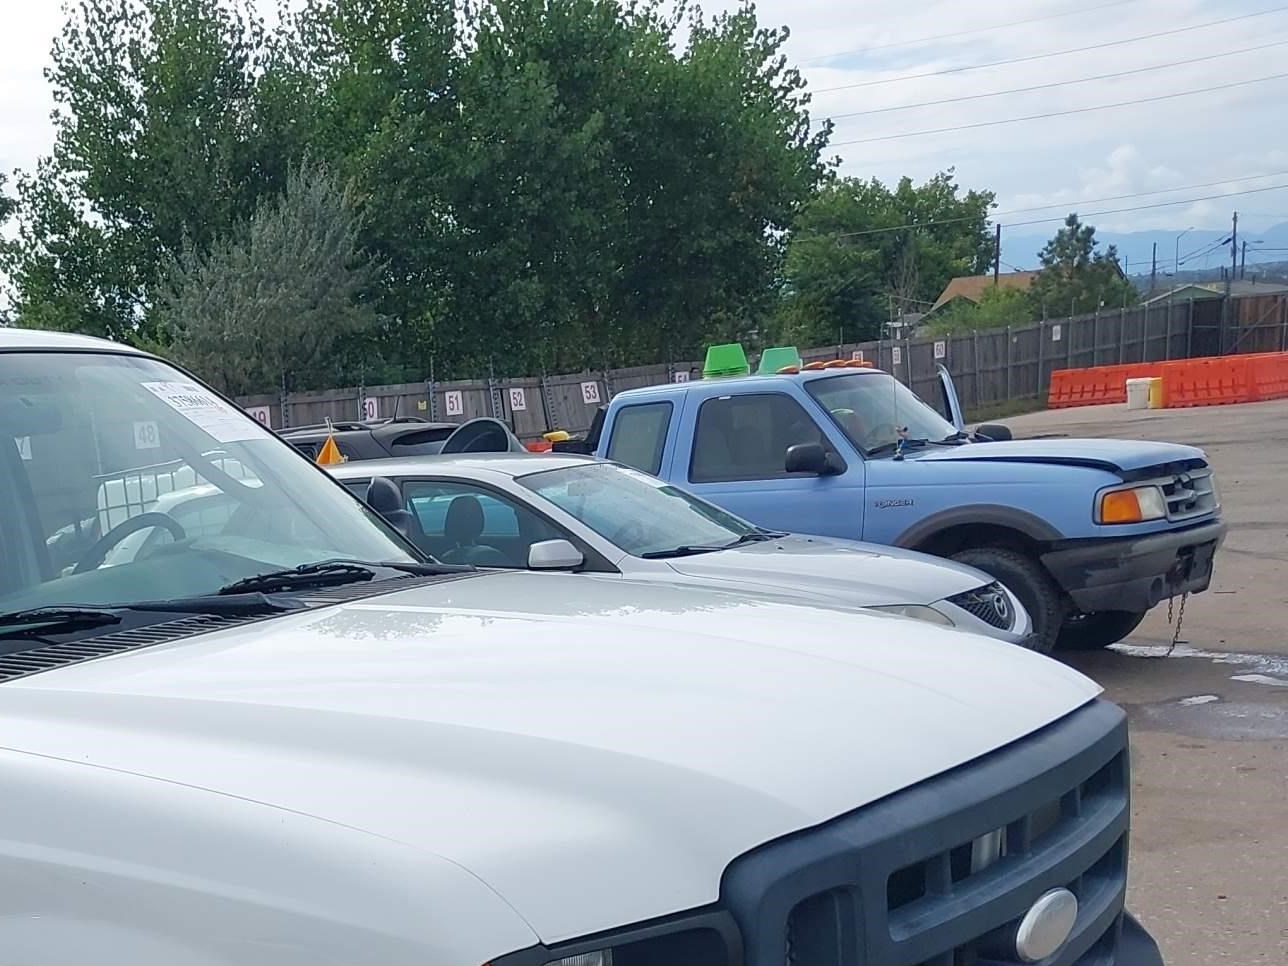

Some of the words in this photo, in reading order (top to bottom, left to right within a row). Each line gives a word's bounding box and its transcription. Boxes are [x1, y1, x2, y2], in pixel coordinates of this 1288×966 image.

[512, 391, 524, 407] 52
[583, 385, 598, 400] 53
[448, 395, 460, 411] 51
[139, 424, 155, 443] 48
